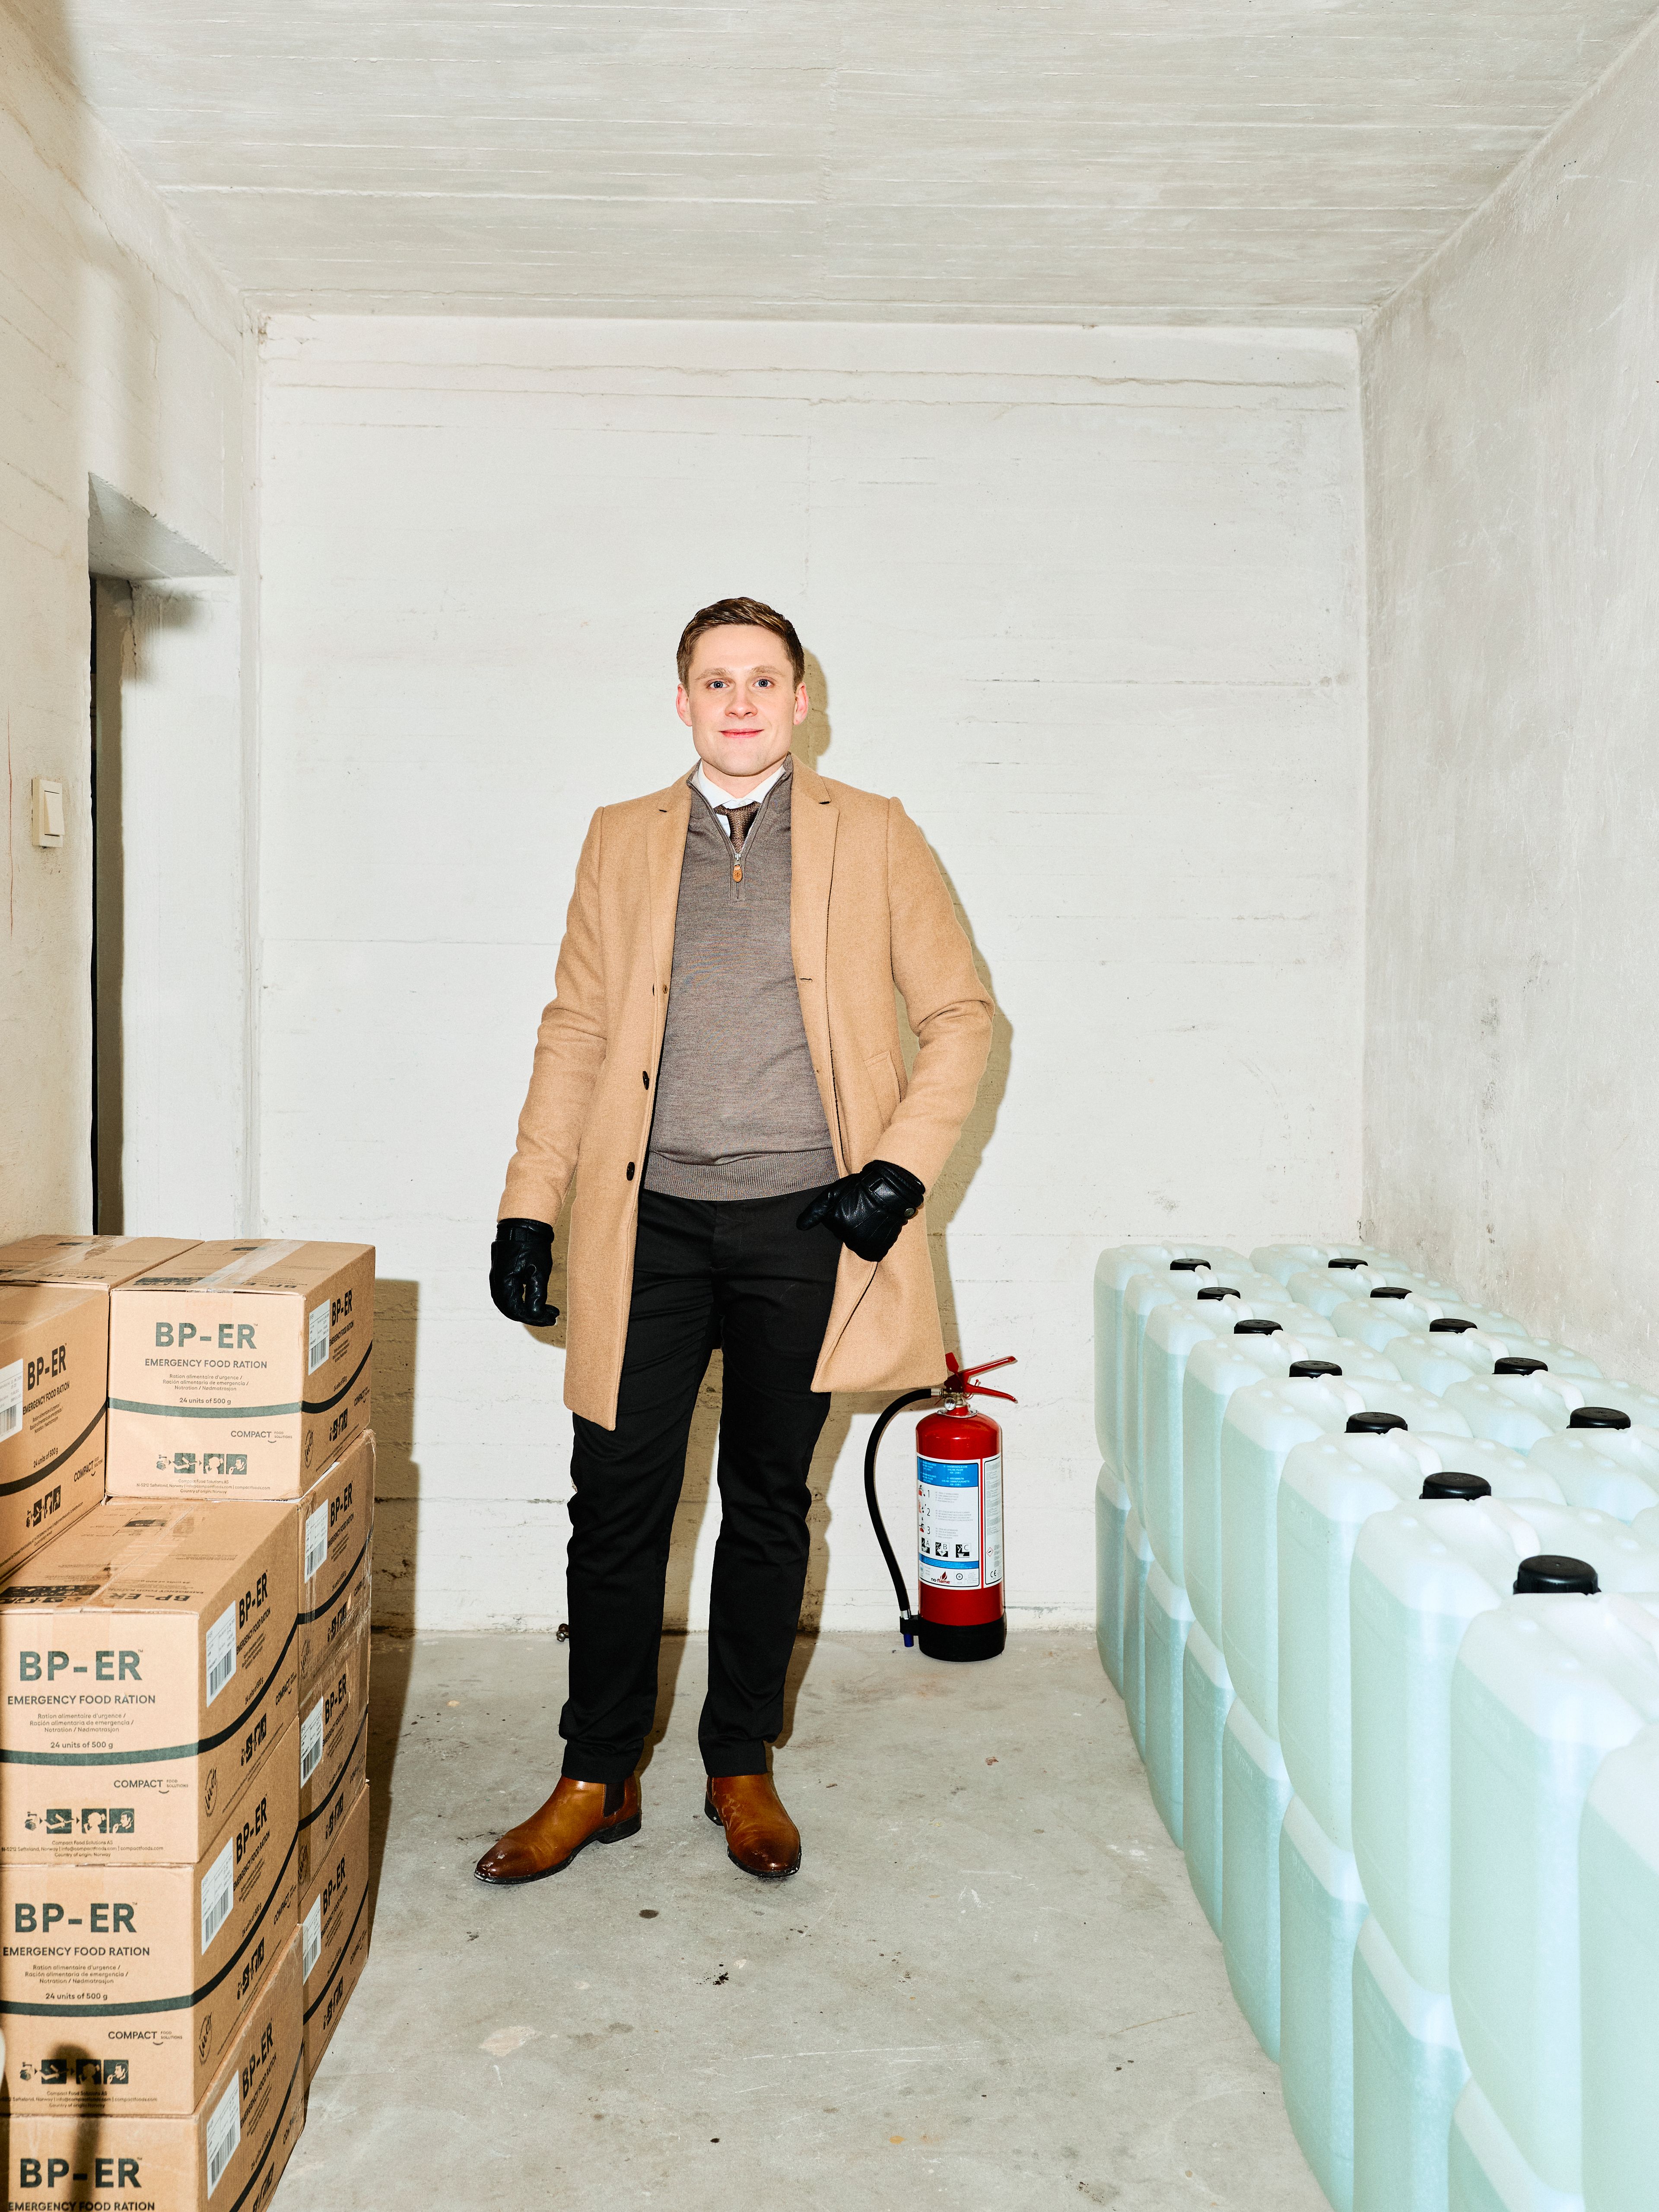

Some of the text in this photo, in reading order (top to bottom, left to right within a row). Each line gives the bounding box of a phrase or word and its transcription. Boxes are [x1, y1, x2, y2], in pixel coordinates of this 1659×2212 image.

[145, 1358, 267, 1369] EMERGENCY FOOD RATION
[23, 1381, 70, 1415] EMERGENCY FOOD RATION
[46, 1451, 50, 1462] of
[74, 1460, 94, 1482] COMPACT
[927, 1508, 930, 1516] 2
[927, 1526, 930, 1535] 3
[236, 1627, 254, 1656] EMERGENCY
[276, 1678, 290, 1706] COMPACT
[8, 1695, 156, 1705] EMERGENCY FOOD RATION
[114, 1780, 163, 1788] COMPACT
[233, 1860, 251, 1892] EMERGENCY
[251, 1846, 260, 1864] FOOD
[260, 1829, 270, 1854] RATION
[274, 1892, 289, 1925] COMPACT
[3, 1947, 150, 1956] EMERGENCY FOOD RATION
[240, 2090, 260, 2129] EMERGENCY
[8, 2202, 155, 2211] EMERGENCY FOOD RATION
